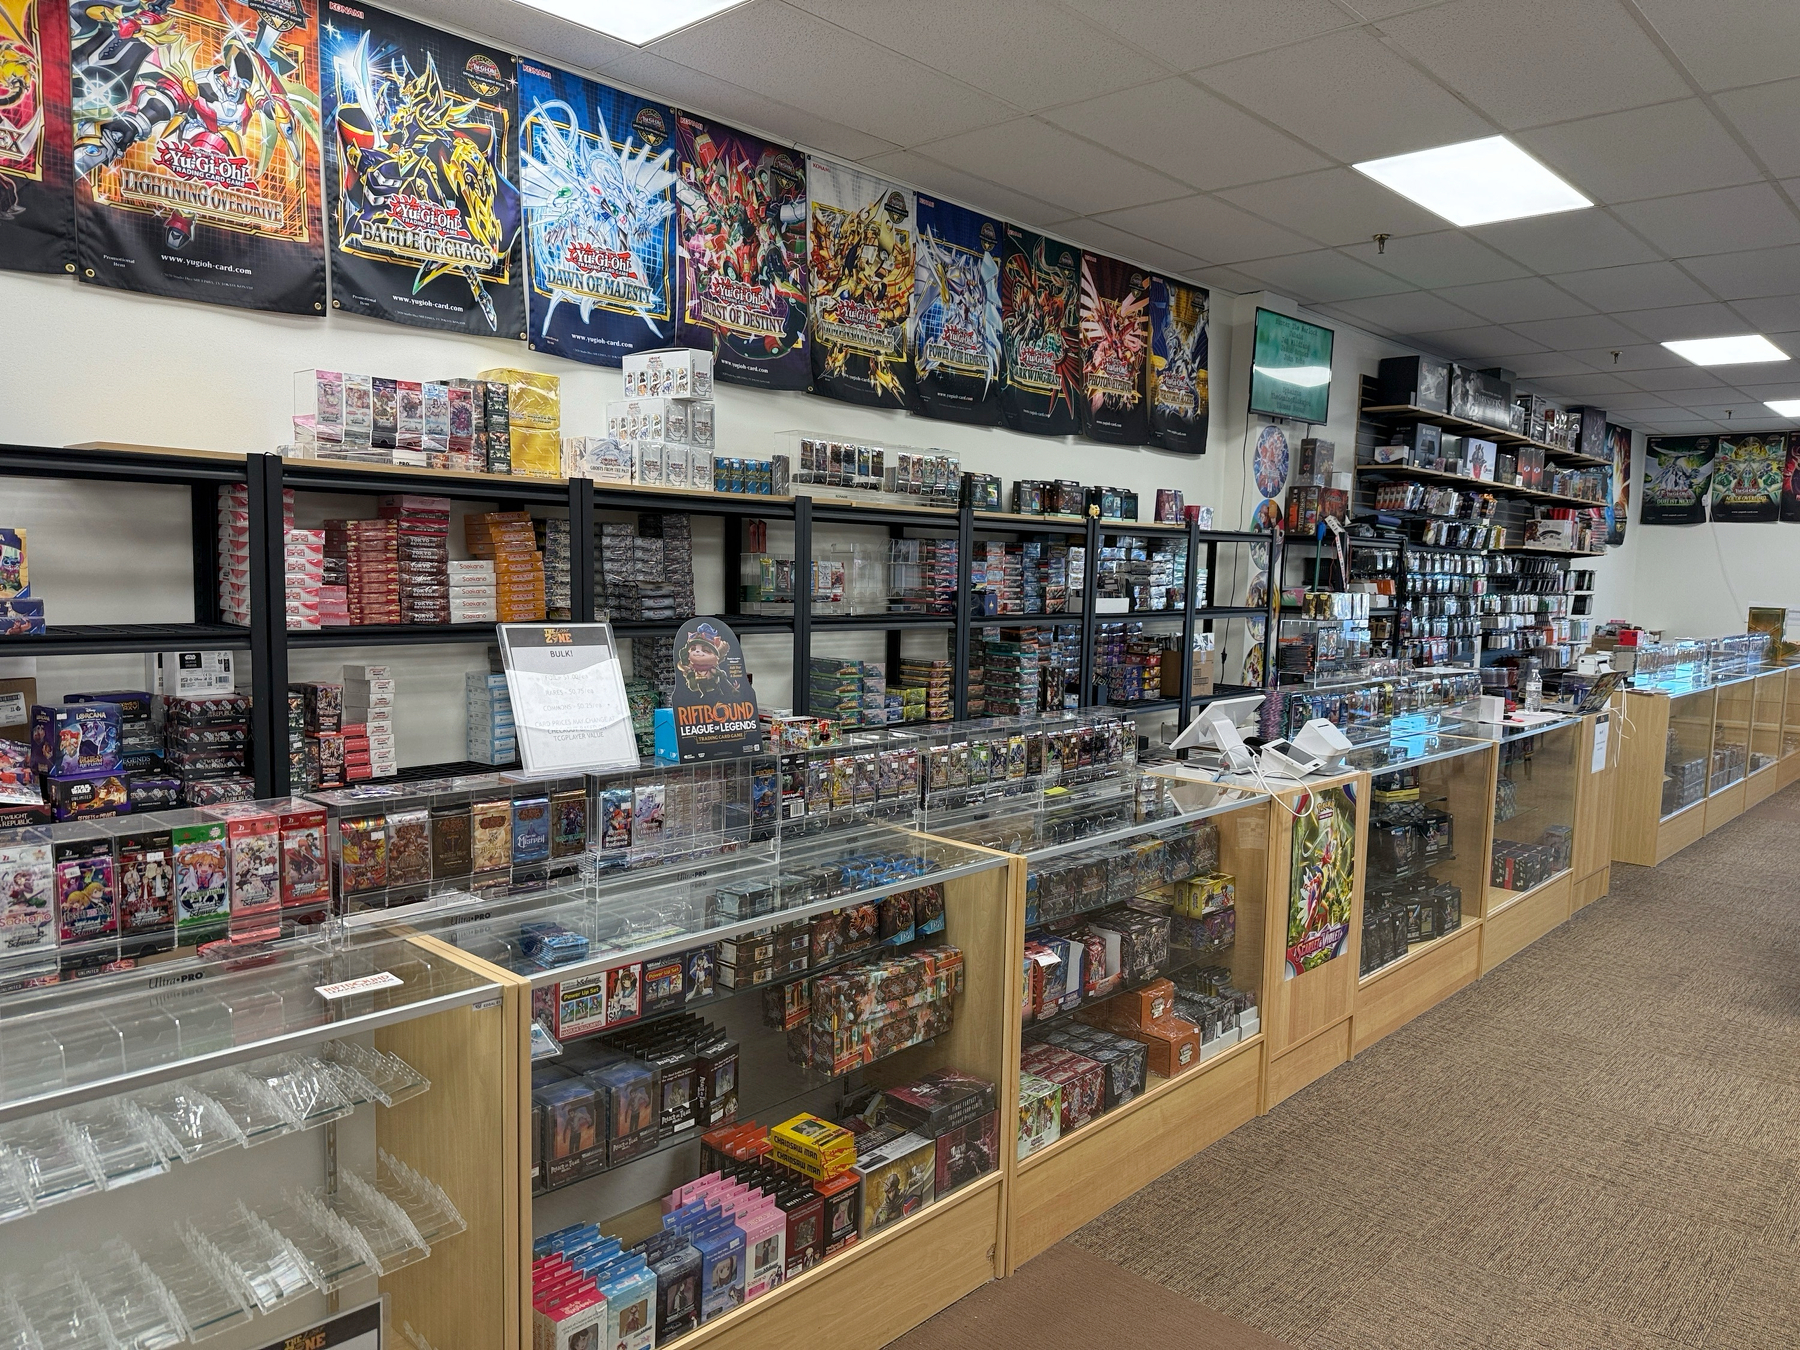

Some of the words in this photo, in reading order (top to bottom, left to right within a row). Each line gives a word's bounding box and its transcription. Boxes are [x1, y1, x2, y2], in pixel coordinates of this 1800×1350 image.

[329, 1, 365, 19] KONAMI
[522, 64, 552, 79] KONAMI
[172, 165, 204, 178] TRADING
[205, 172, 225, 183] CARD
[226, 177, 245, 188] GAME
[123, 171, 210, 207] LIGHTNING
[212, 187, 283, 222] OVERDRIVE
[402, 217, 427, 229] TRADING
[428, 223, 442, 232] CARD
[442, 227, 457, 236] GAME
[362, 222, 420, 250] BATTLE
[424, 235, 441, 253] OF
[445, 240, 492, 264] CHAOS
[161, 254, 252, 275] www.yugioh-card.com
[547, 267, 584, 290] DAWN
[587, 275, 602, 292] OF
[603, 278, 652, 304] MAJESTY
[392, 294, 464, 312] www.yugioh-card.com
[702, 299, 727, 319] BURST
[729, 306, 741, 322] OF
[743, 309, 784, 334] DESTINY
[571, 333, 634, 349] www.yugioh-card.com
[721, 359, 769, 373] www.yugioh-card.com
[544, 633, 573, 643] ZONE
[549, 650, 574, 658] BULK!
[76, 711, 107, 720] LORCANA
[677, 700, 755, 726] RIFTBOUND
[534, 720, 551, 728] CARD
[552, 718, 572, 727] PRICES
[572, 718, 586, 726] MAY
[585, 716, 608, 725] CHANGE
[681, 723, 715, 736] LEAGUE
[720, 720, 757, 733] LEGENDS
[553, 733, 586, 742] TCGPLAYER
[587, 731, 604, 739] VALUE
[2, 818, 34, 827] REPUBLIC
[649, 971, 664, 980] Power
[664, 969, 672, 977] Up
[672, 966, 681, 974] Set
[563, 991, 580, 1000] Power
[581, 989, 588, 998] Up
[589, 986, 600, 995] Set
[773, 1134, 803, 1155] CHAINSAW
[803, 1148, 818, 1161] MAN
[776, 1151, 806, 1170] CHAINSAW
[806, 1164, 821, 1177] MAN
